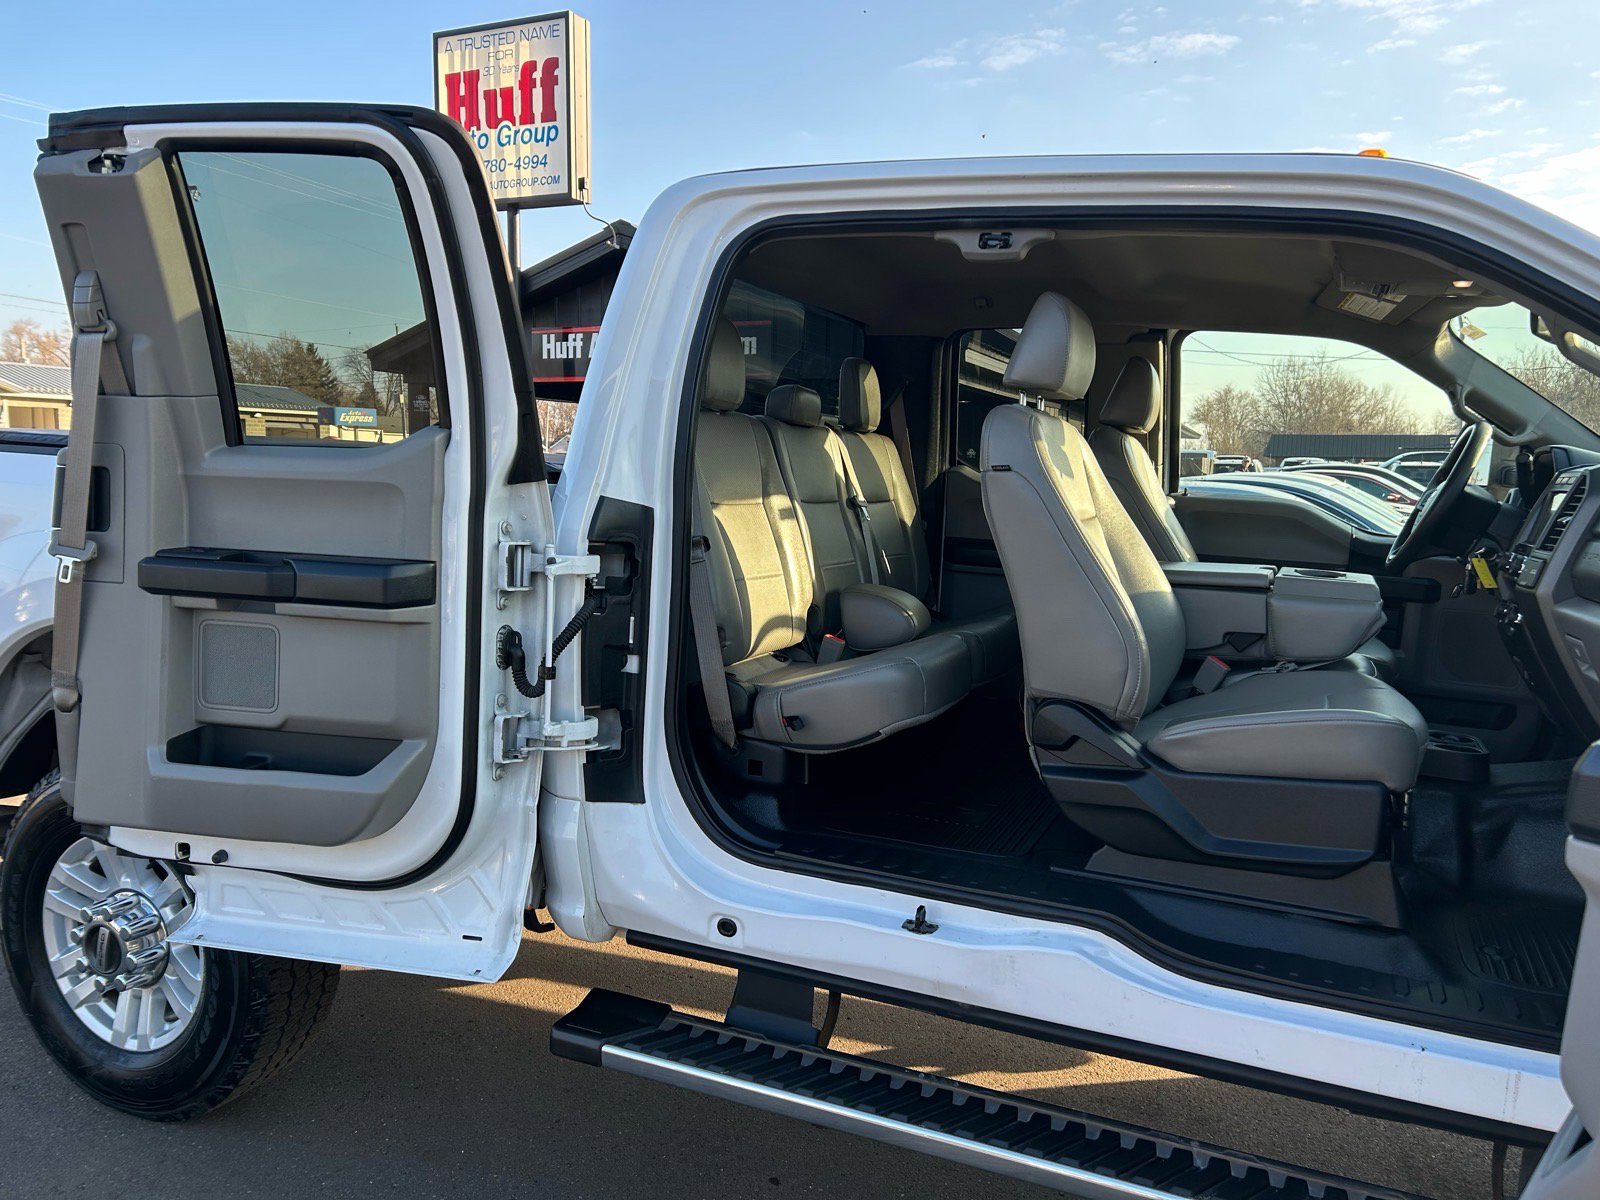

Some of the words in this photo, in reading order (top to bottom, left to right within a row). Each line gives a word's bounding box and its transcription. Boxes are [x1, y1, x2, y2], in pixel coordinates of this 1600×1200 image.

[444, 41, 454, 54] A
[457, 30, 516, 51] TRUSTED
[519, 23, 560, 42] NAME
[487, 49, 514, 61] FOR
[498, 63, 520, 74] Years
[445, 57, 560, 132] Huff
[497, 124, 559, 148] Group
[489, 174, 561, 190] UTOGROUP.COM
[542, 332, 584, 360] Huff
[339, 412, 375, 424] Express
